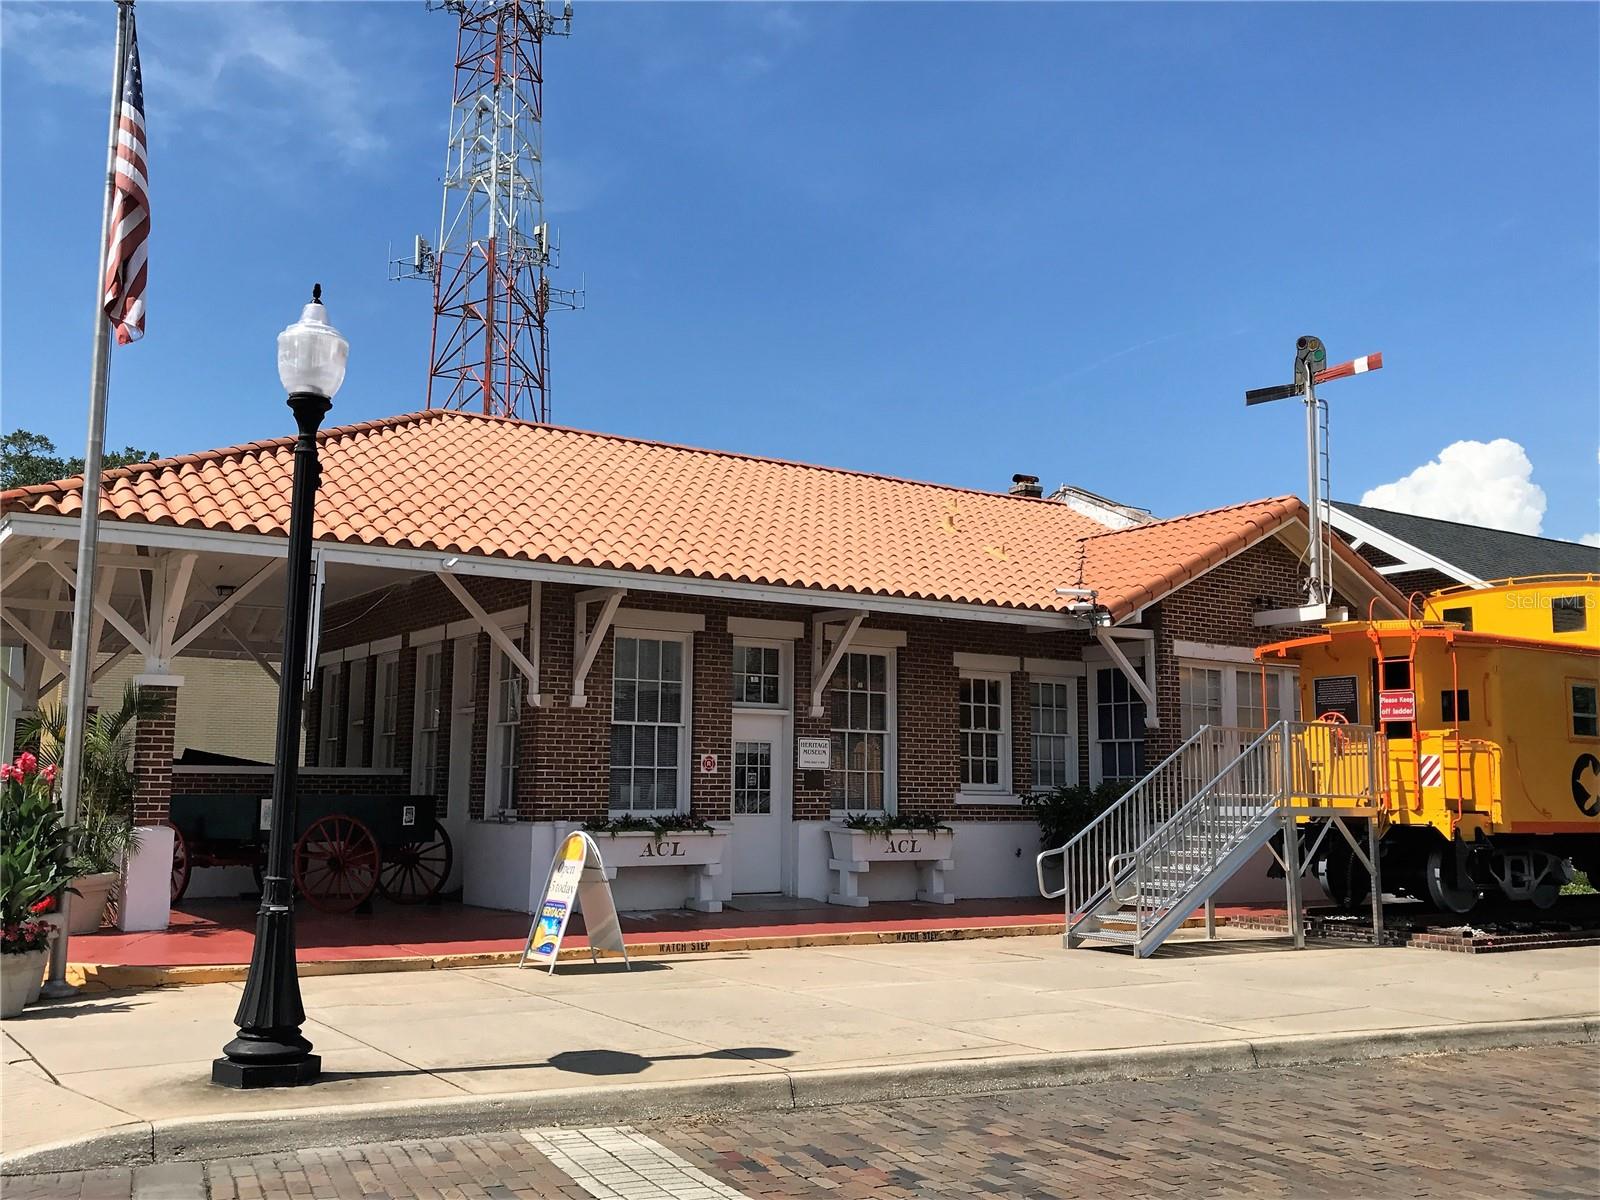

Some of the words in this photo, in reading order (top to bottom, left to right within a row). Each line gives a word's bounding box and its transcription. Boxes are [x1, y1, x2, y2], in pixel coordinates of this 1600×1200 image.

[1381, 707, 1391, 715] off
[1392, 707, 1413, 715] ladder
[801, 741, 828, 749] HERITAGE
[639, 841, 686, 858] ACL
[885, 840, 922, 854] ACL
[557, 861, 576, 878] Open
[896, 931, 919, 941] WATCH
[922, 930, 939, 940] STEP
[659, 943, 687, 953] WATCH
[691, 941, 711, 951] STEP
